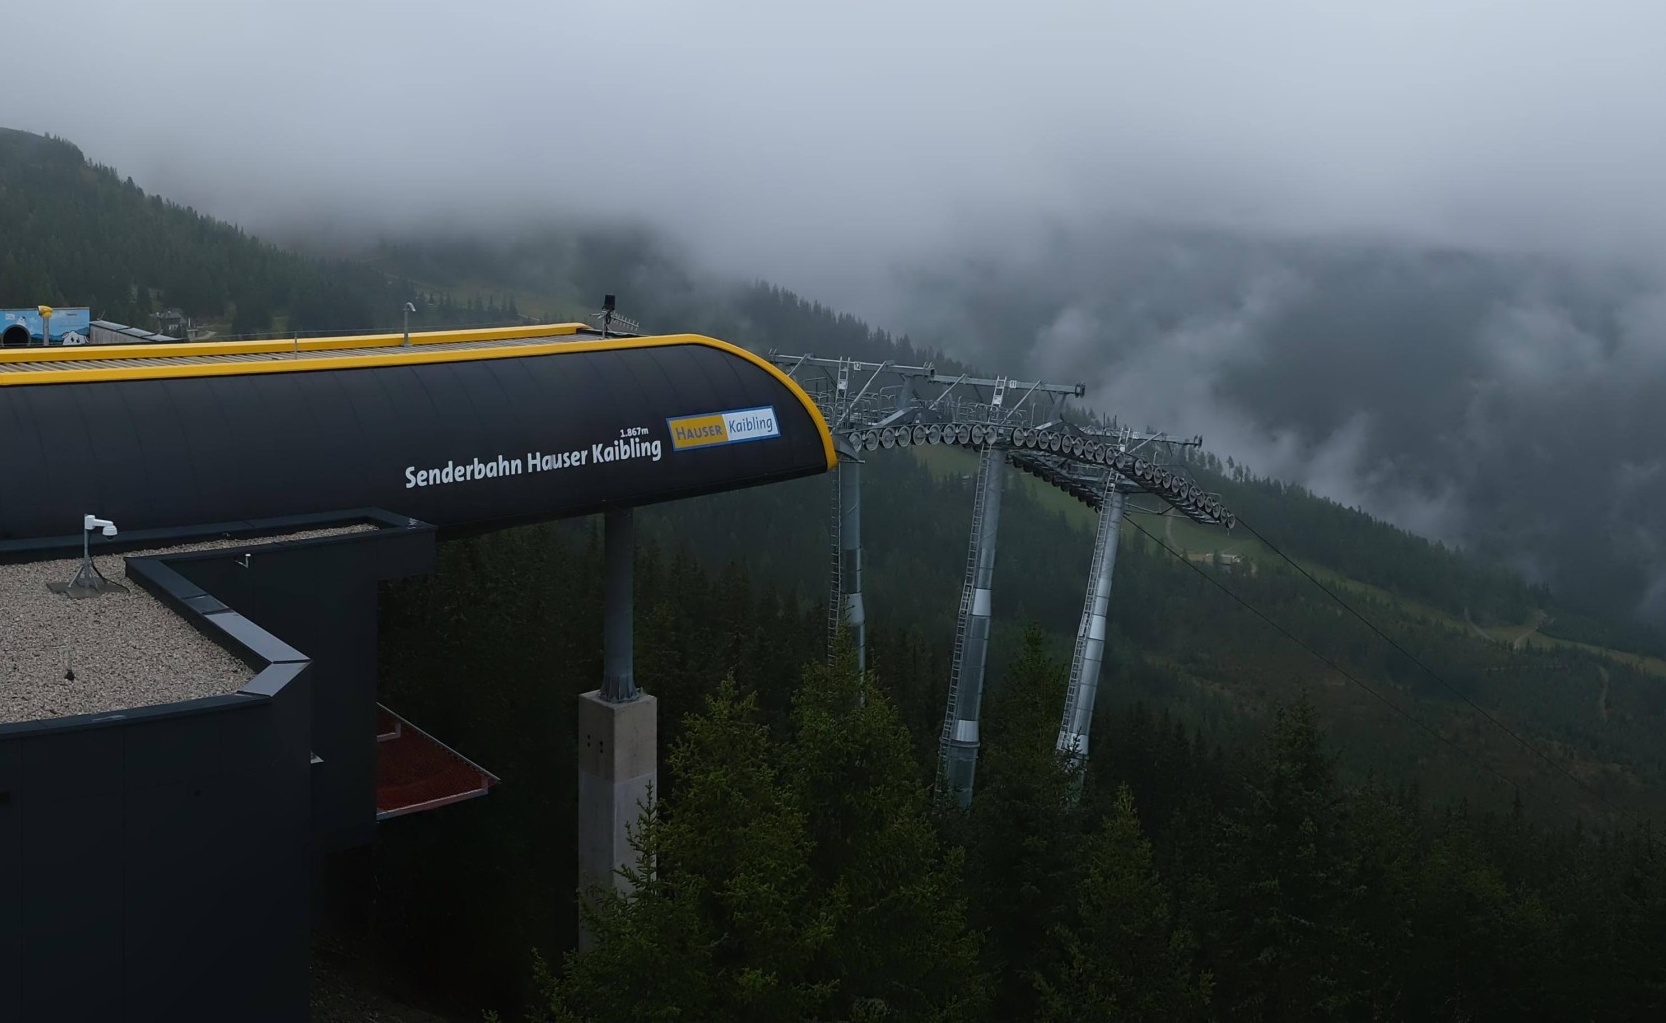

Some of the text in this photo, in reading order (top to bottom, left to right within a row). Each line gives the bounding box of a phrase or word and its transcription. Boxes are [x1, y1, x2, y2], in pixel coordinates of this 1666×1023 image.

[619, 427, 649, 438] 1.867m
[675, 416, 773, 441] HAUSER Kaibling
[405, 437, 662, 489] Senderbahn Hauser Kaibling
